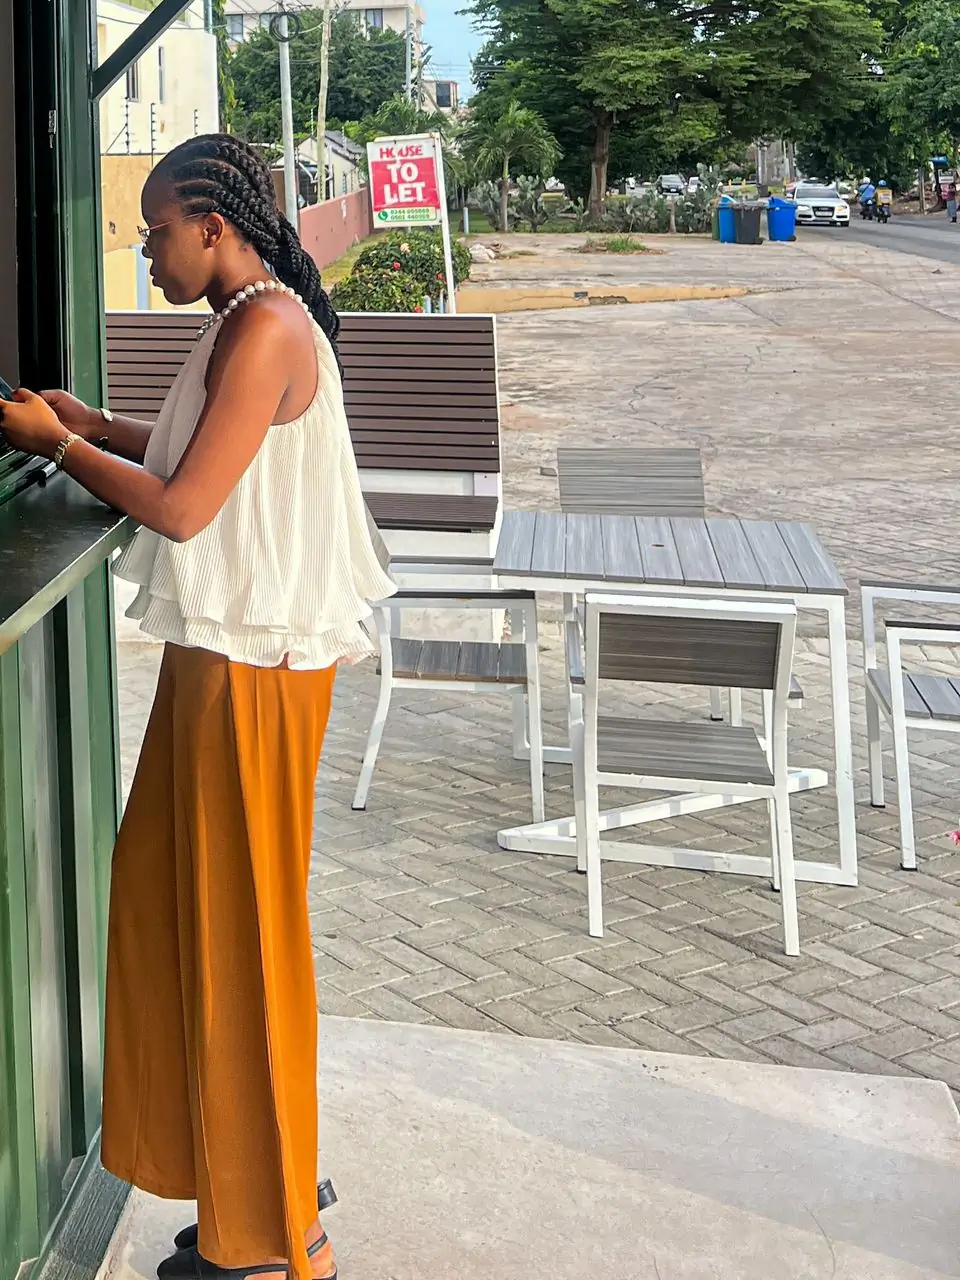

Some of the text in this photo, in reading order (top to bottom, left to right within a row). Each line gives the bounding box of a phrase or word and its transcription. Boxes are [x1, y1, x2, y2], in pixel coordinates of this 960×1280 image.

[379, 145, 423, 158] HOUSE
[387, 161, 419, 183] TO
[383, 182, 426, 205] LET
